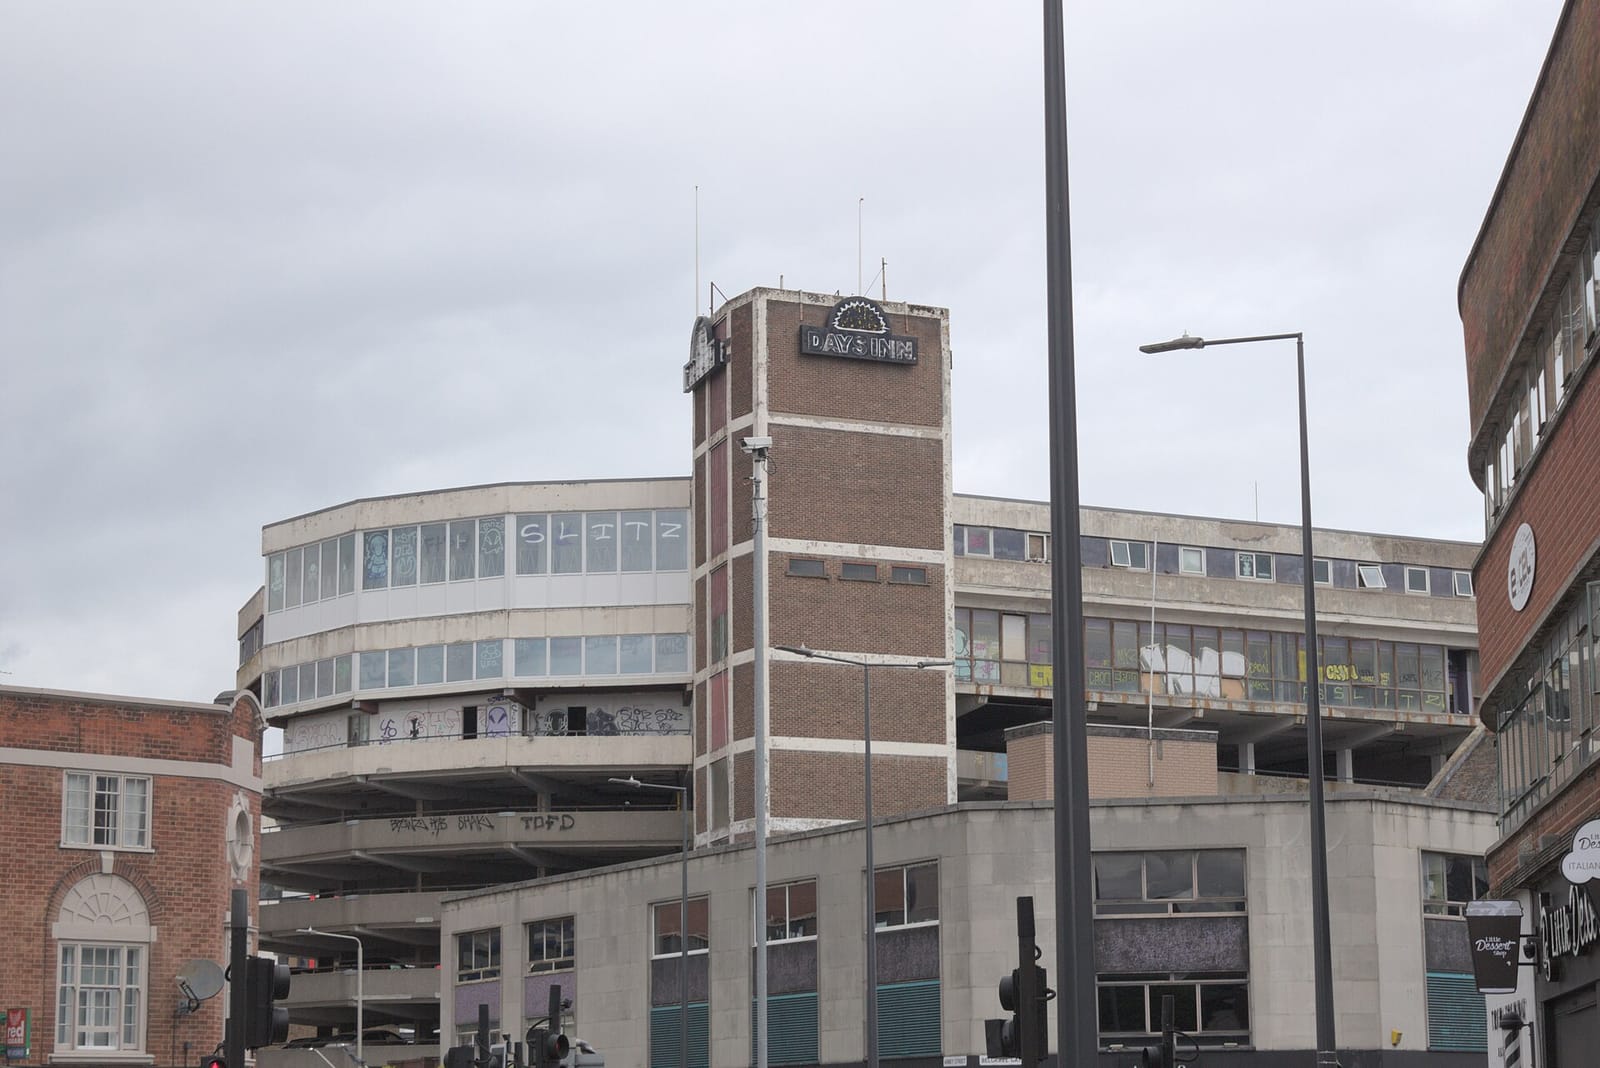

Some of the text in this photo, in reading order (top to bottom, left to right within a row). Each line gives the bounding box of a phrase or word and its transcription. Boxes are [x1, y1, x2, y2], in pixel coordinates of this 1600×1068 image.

[807, 331, 914, 360] DAYS INN
[1569, 885, 1600, 957] Dess
[1475, 939, 1516, 951] Dessert
[8, 1021, 24, 1038] red
